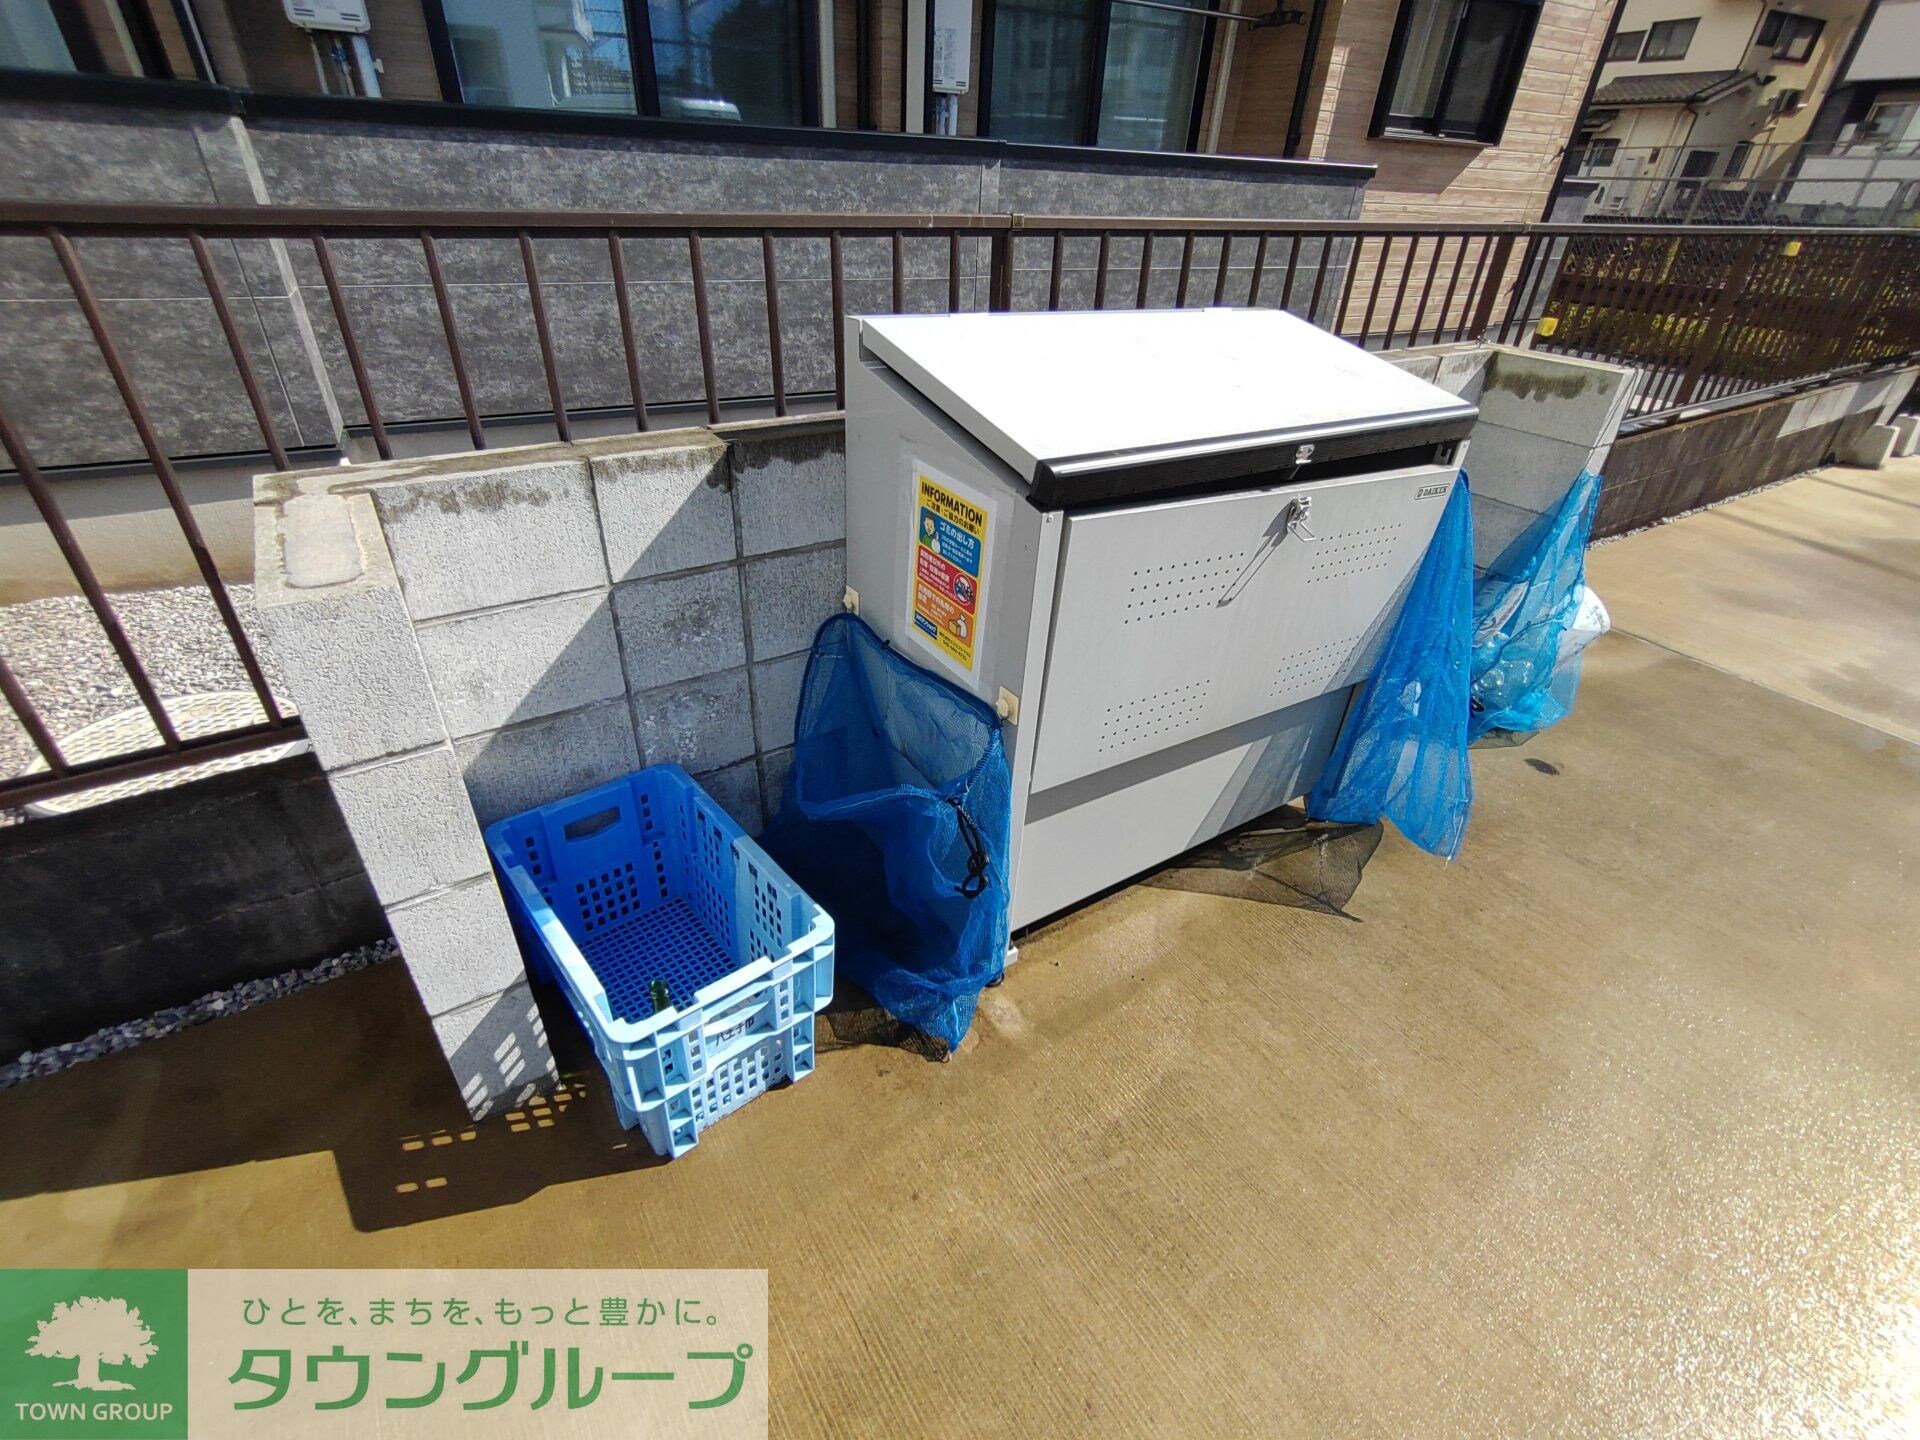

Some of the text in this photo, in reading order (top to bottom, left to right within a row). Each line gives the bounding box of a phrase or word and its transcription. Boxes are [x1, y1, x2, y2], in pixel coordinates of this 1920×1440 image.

[939, 521, 975, 549] ゴミの出し方
